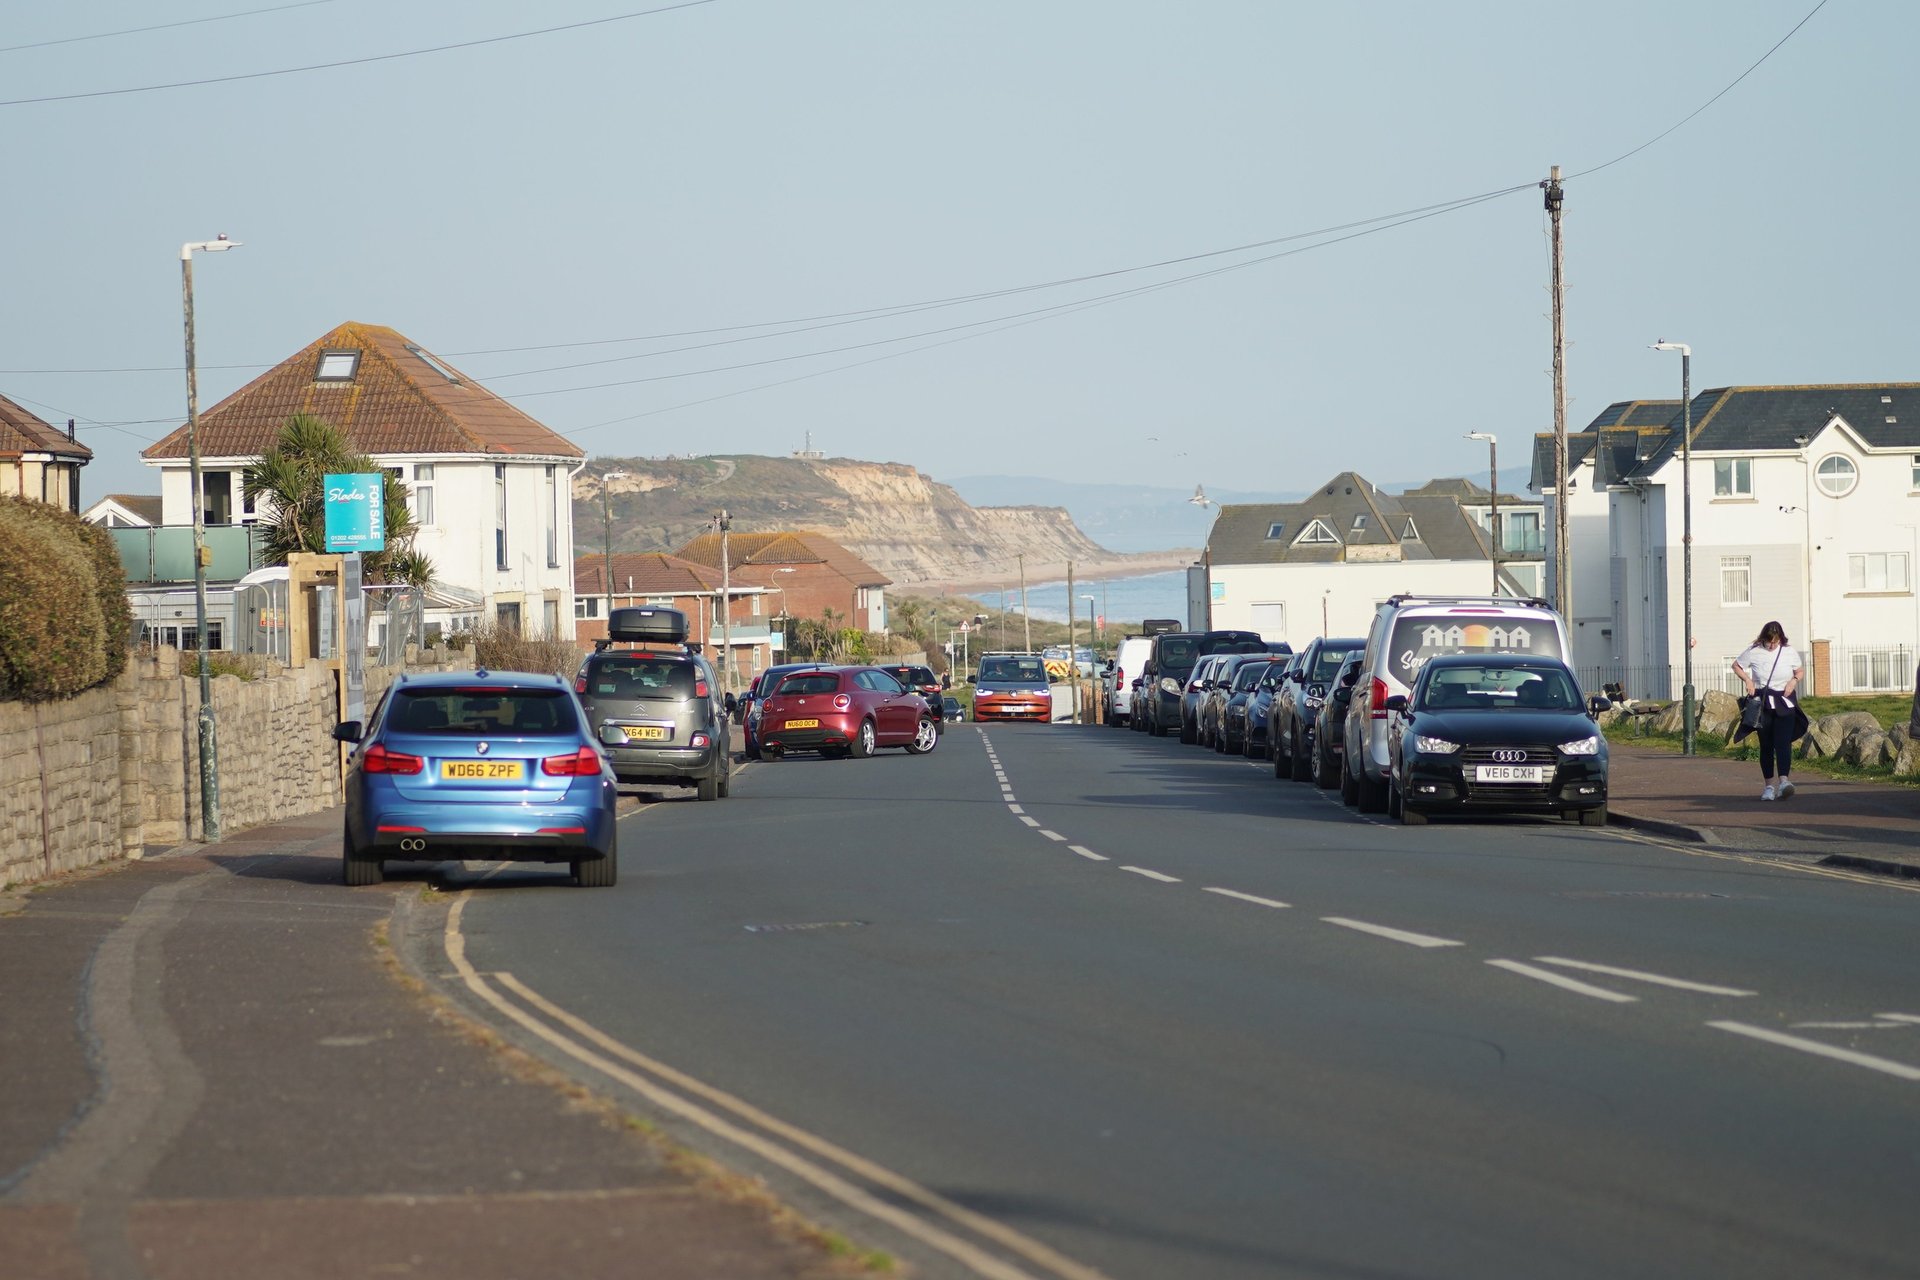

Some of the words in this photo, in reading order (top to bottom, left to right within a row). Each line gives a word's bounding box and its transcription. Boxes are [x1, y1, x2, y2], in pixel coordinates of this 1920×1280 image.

[328, 487, 366, 502] Slades
[369, 485, 380, 508] FOR
[369, 509, 380, 539] SALE
[626, 728, 643, 737] X64
[645, 728, 663, 738] WEW
[448, 764, 484, 777] WD66
[488, 764, 516, 777] ZPF
[1485, 767, 1510, 778] VE16
[1513, 767, 1535, 778] CXH
